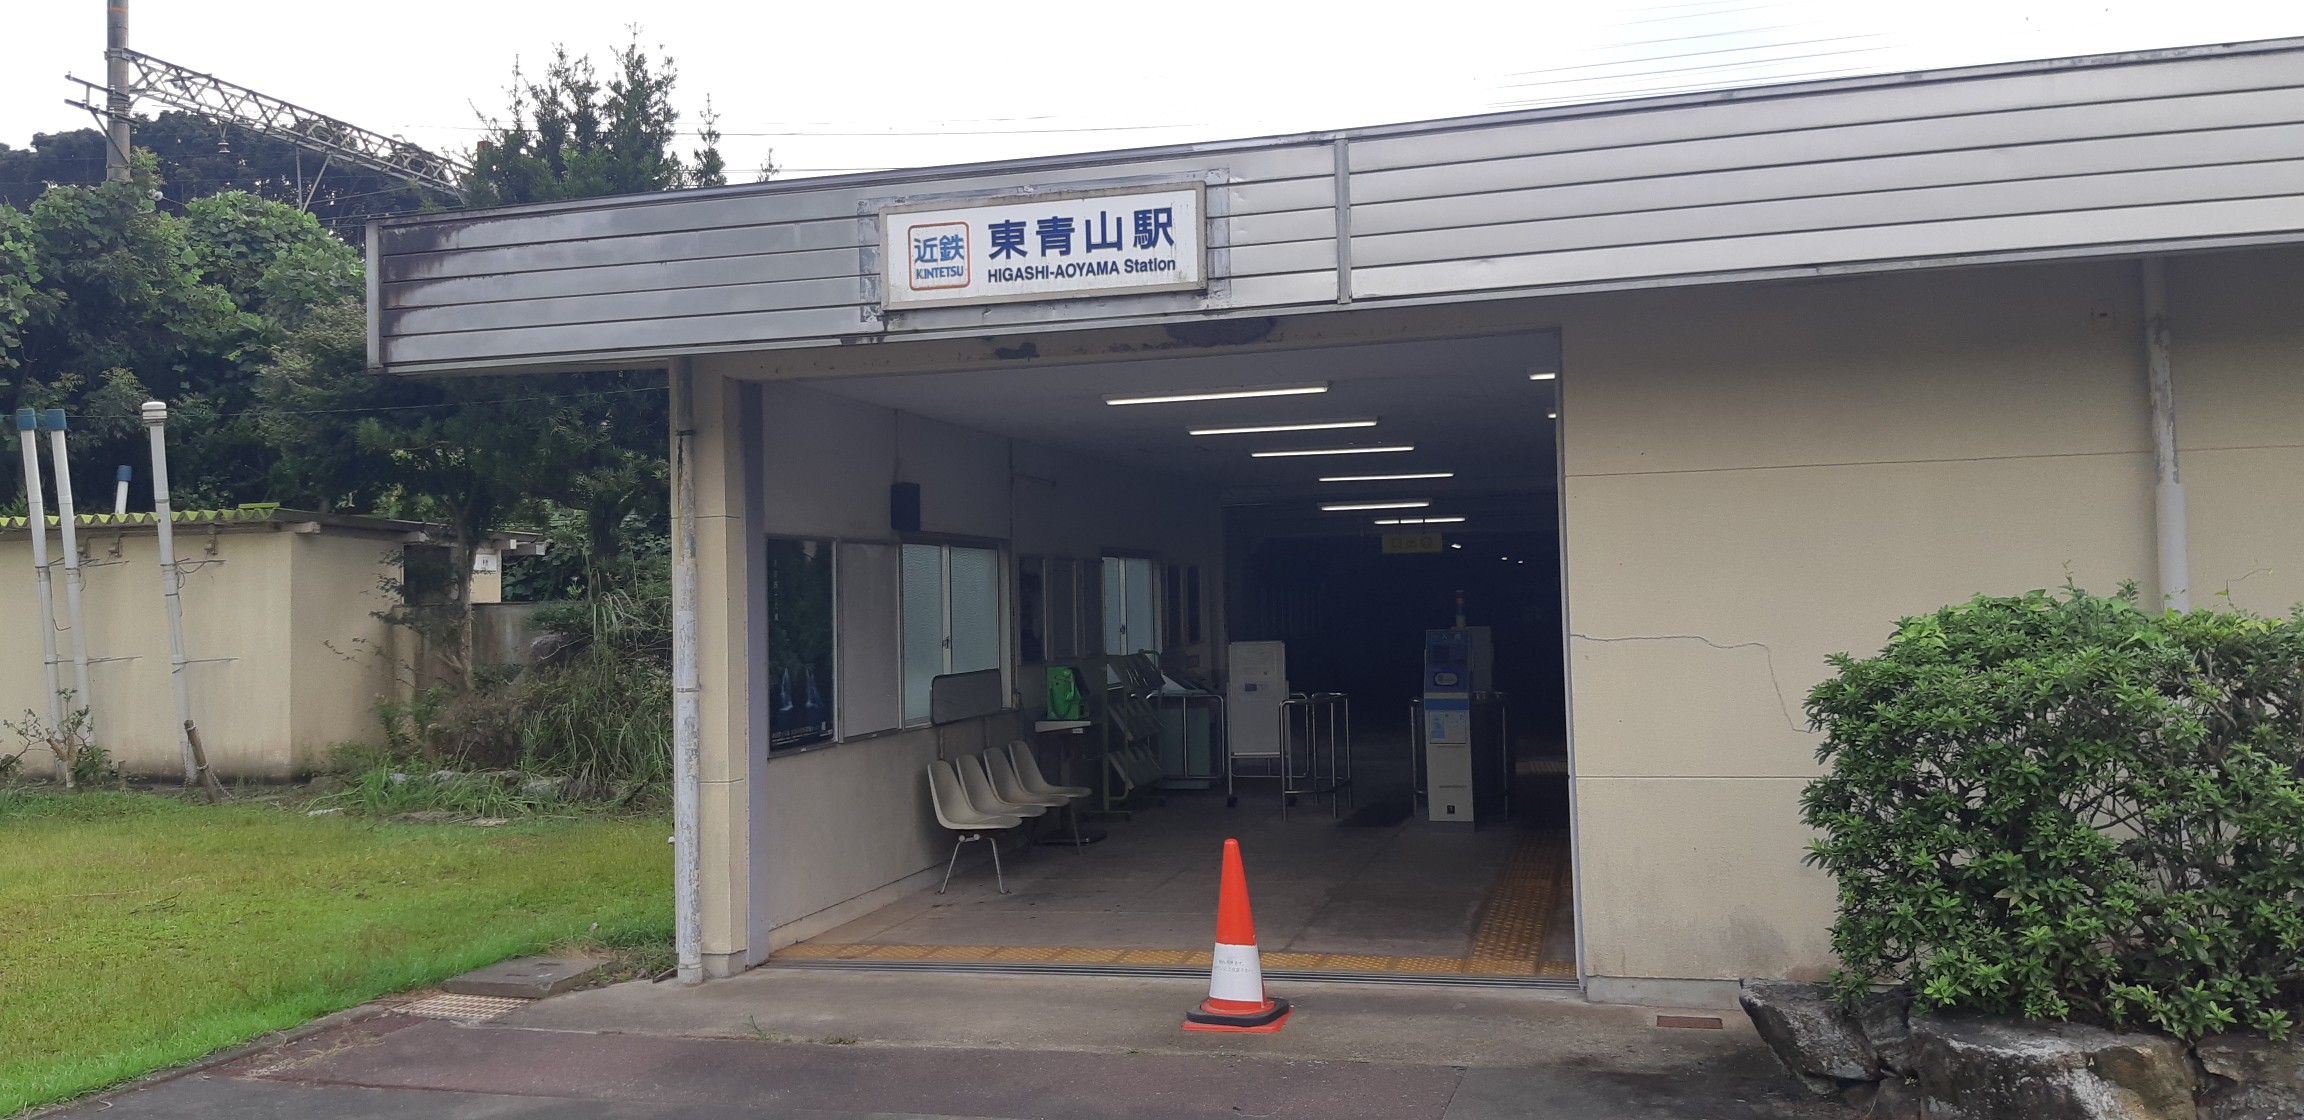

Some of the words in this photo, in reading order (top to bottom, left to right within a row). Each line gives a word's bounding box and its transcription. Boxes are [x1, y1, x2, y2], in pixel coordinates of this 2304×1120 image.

[987, 207, 1175, 260] 東青山駅
[914, 234, 965, 264] 近鉄
[916, 266, 965, 279] KINTETSU
[987, 260, 1120, 283] HIGASHI-AOYAMA
[1124, 257, 1176, 273] Station
